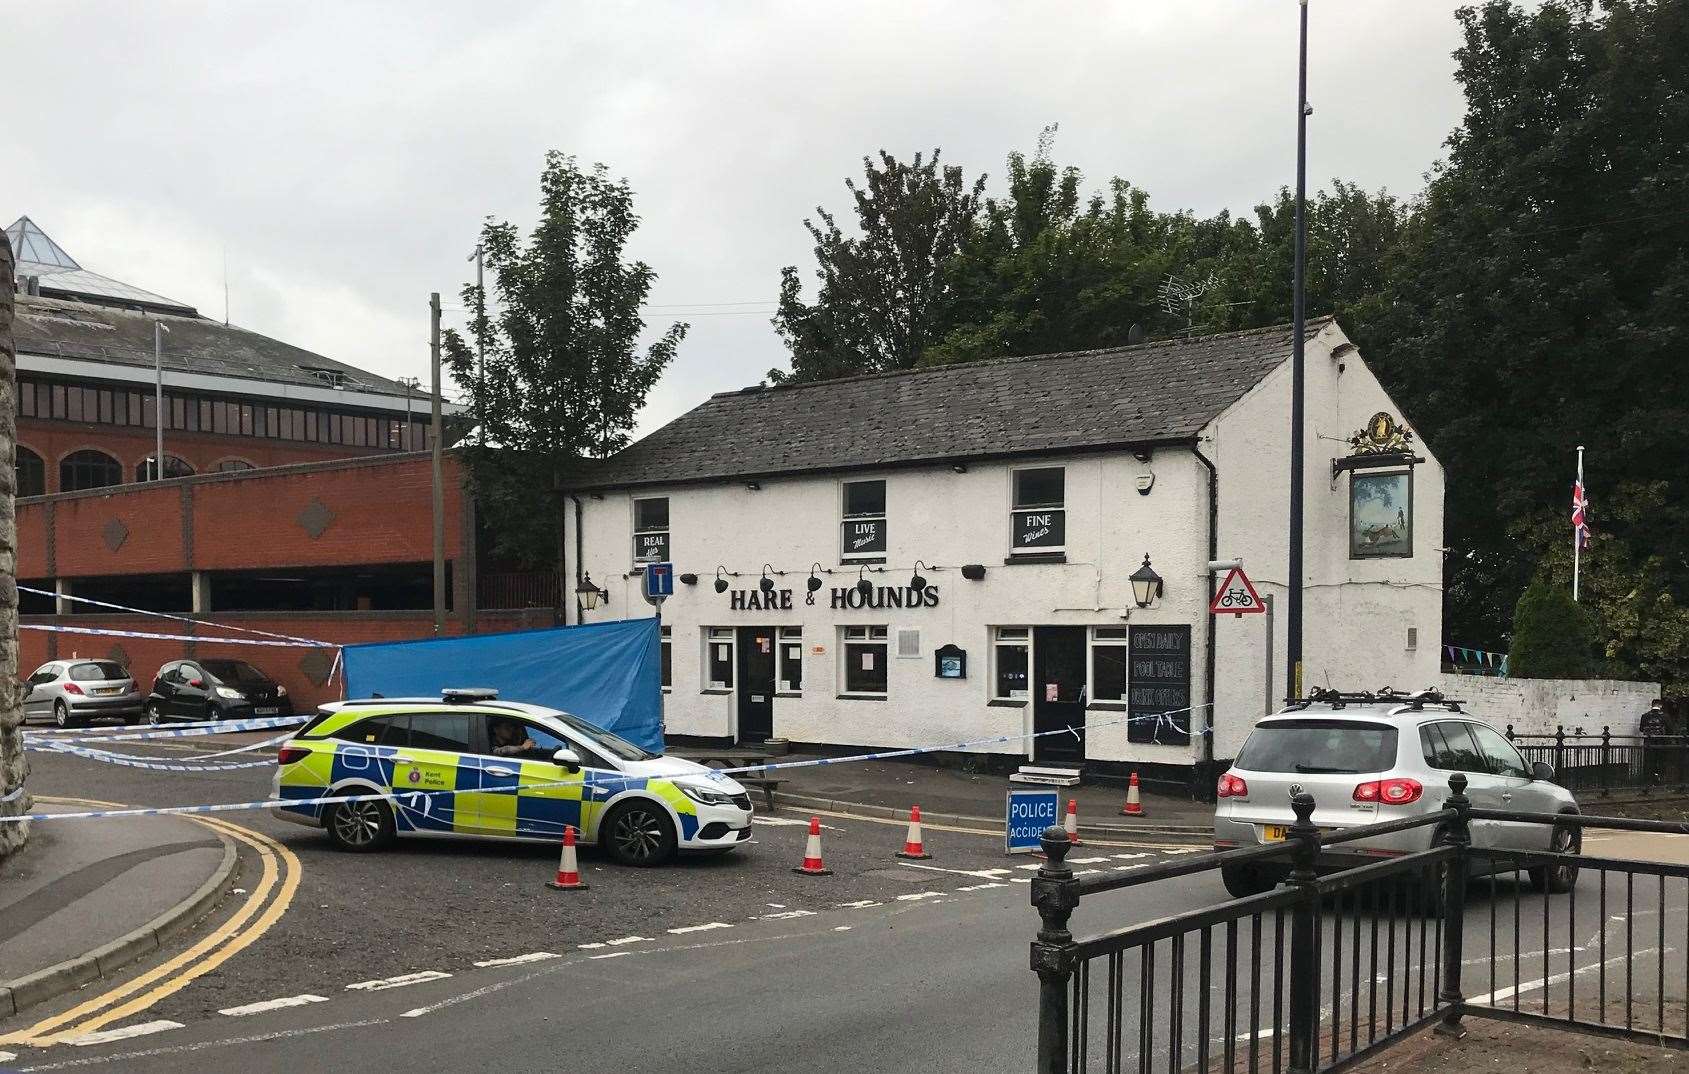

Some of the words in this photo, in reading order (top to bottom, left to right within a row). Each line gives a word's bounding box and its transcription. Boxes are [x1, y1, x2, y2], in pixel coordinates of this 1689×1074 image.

[1027, 514, 1051, 527] FINE
[855, 523, 875, 534] LIVE
[1023, 527, 1049, 543] Wines
[644, 537, 664, 546] REAL
[853, 534, 875, 549] Music
[730, 588, 793, 610] HARE
[805, 591, 815, 606] &
[830, 585, 940, 609] HOUNDS
[1157, 632, 1184, 649] DAILY
[1134, 661, 1155, 678] POOL
[1156, 661, 1184, 678] TABLE
[1011, 803, 1054, 818] POLICE
[1011, 826, 1046, 838] ACCIDE
